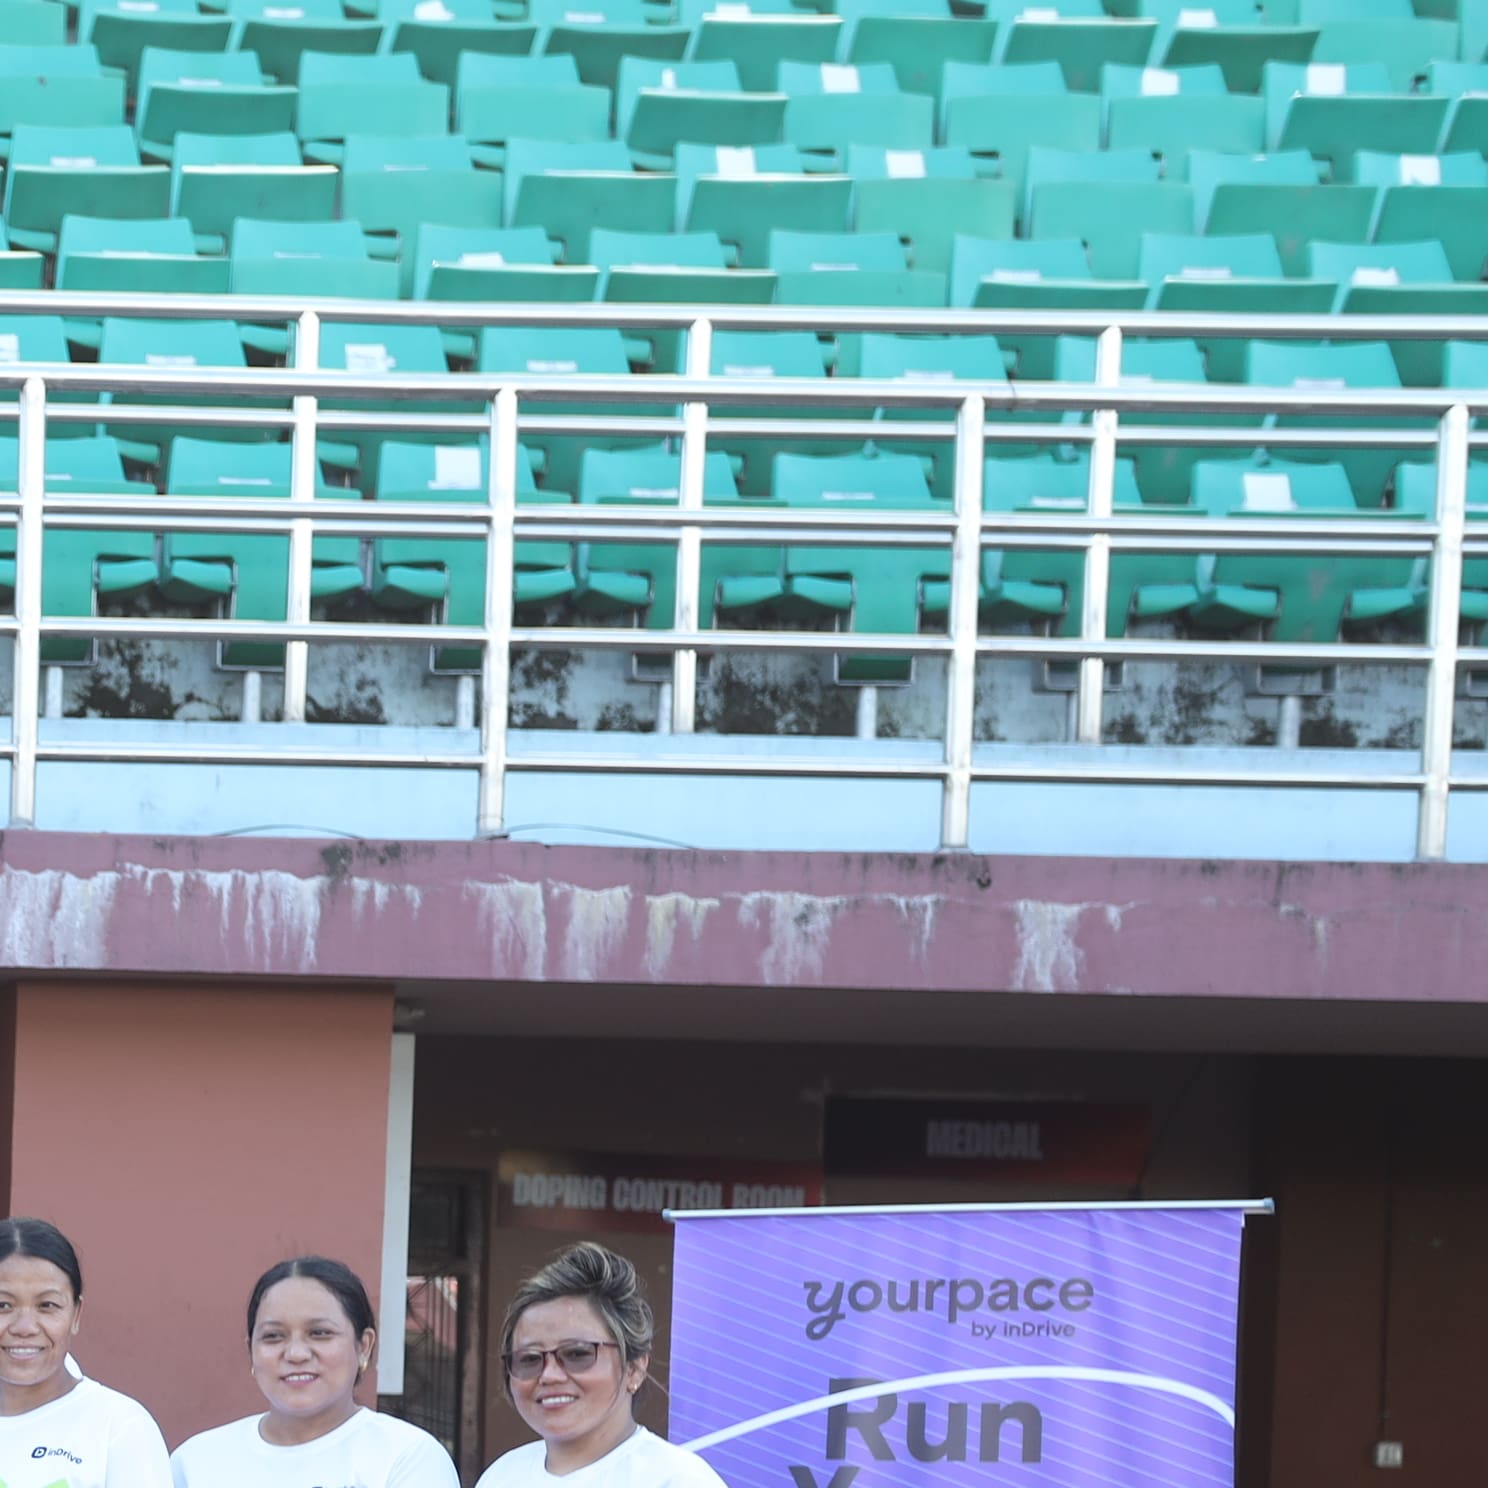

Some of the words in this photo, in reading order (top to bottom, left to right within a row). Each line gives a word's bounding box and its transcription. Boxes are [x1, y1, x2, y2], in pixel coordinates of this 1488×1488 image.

[927, 1121, 1042, 1160] MEDICAL
[513, 1174, 607, 1209] DOPING
[613, 1177, 724, 1212] CONTROL
[803, 1277, 1094, 1340] yourpace
[971, 1321, 997, 1340] by
[1002, 1320, 1075, 1338] inDrive
[825, 1377, 1043, 1463] Run
